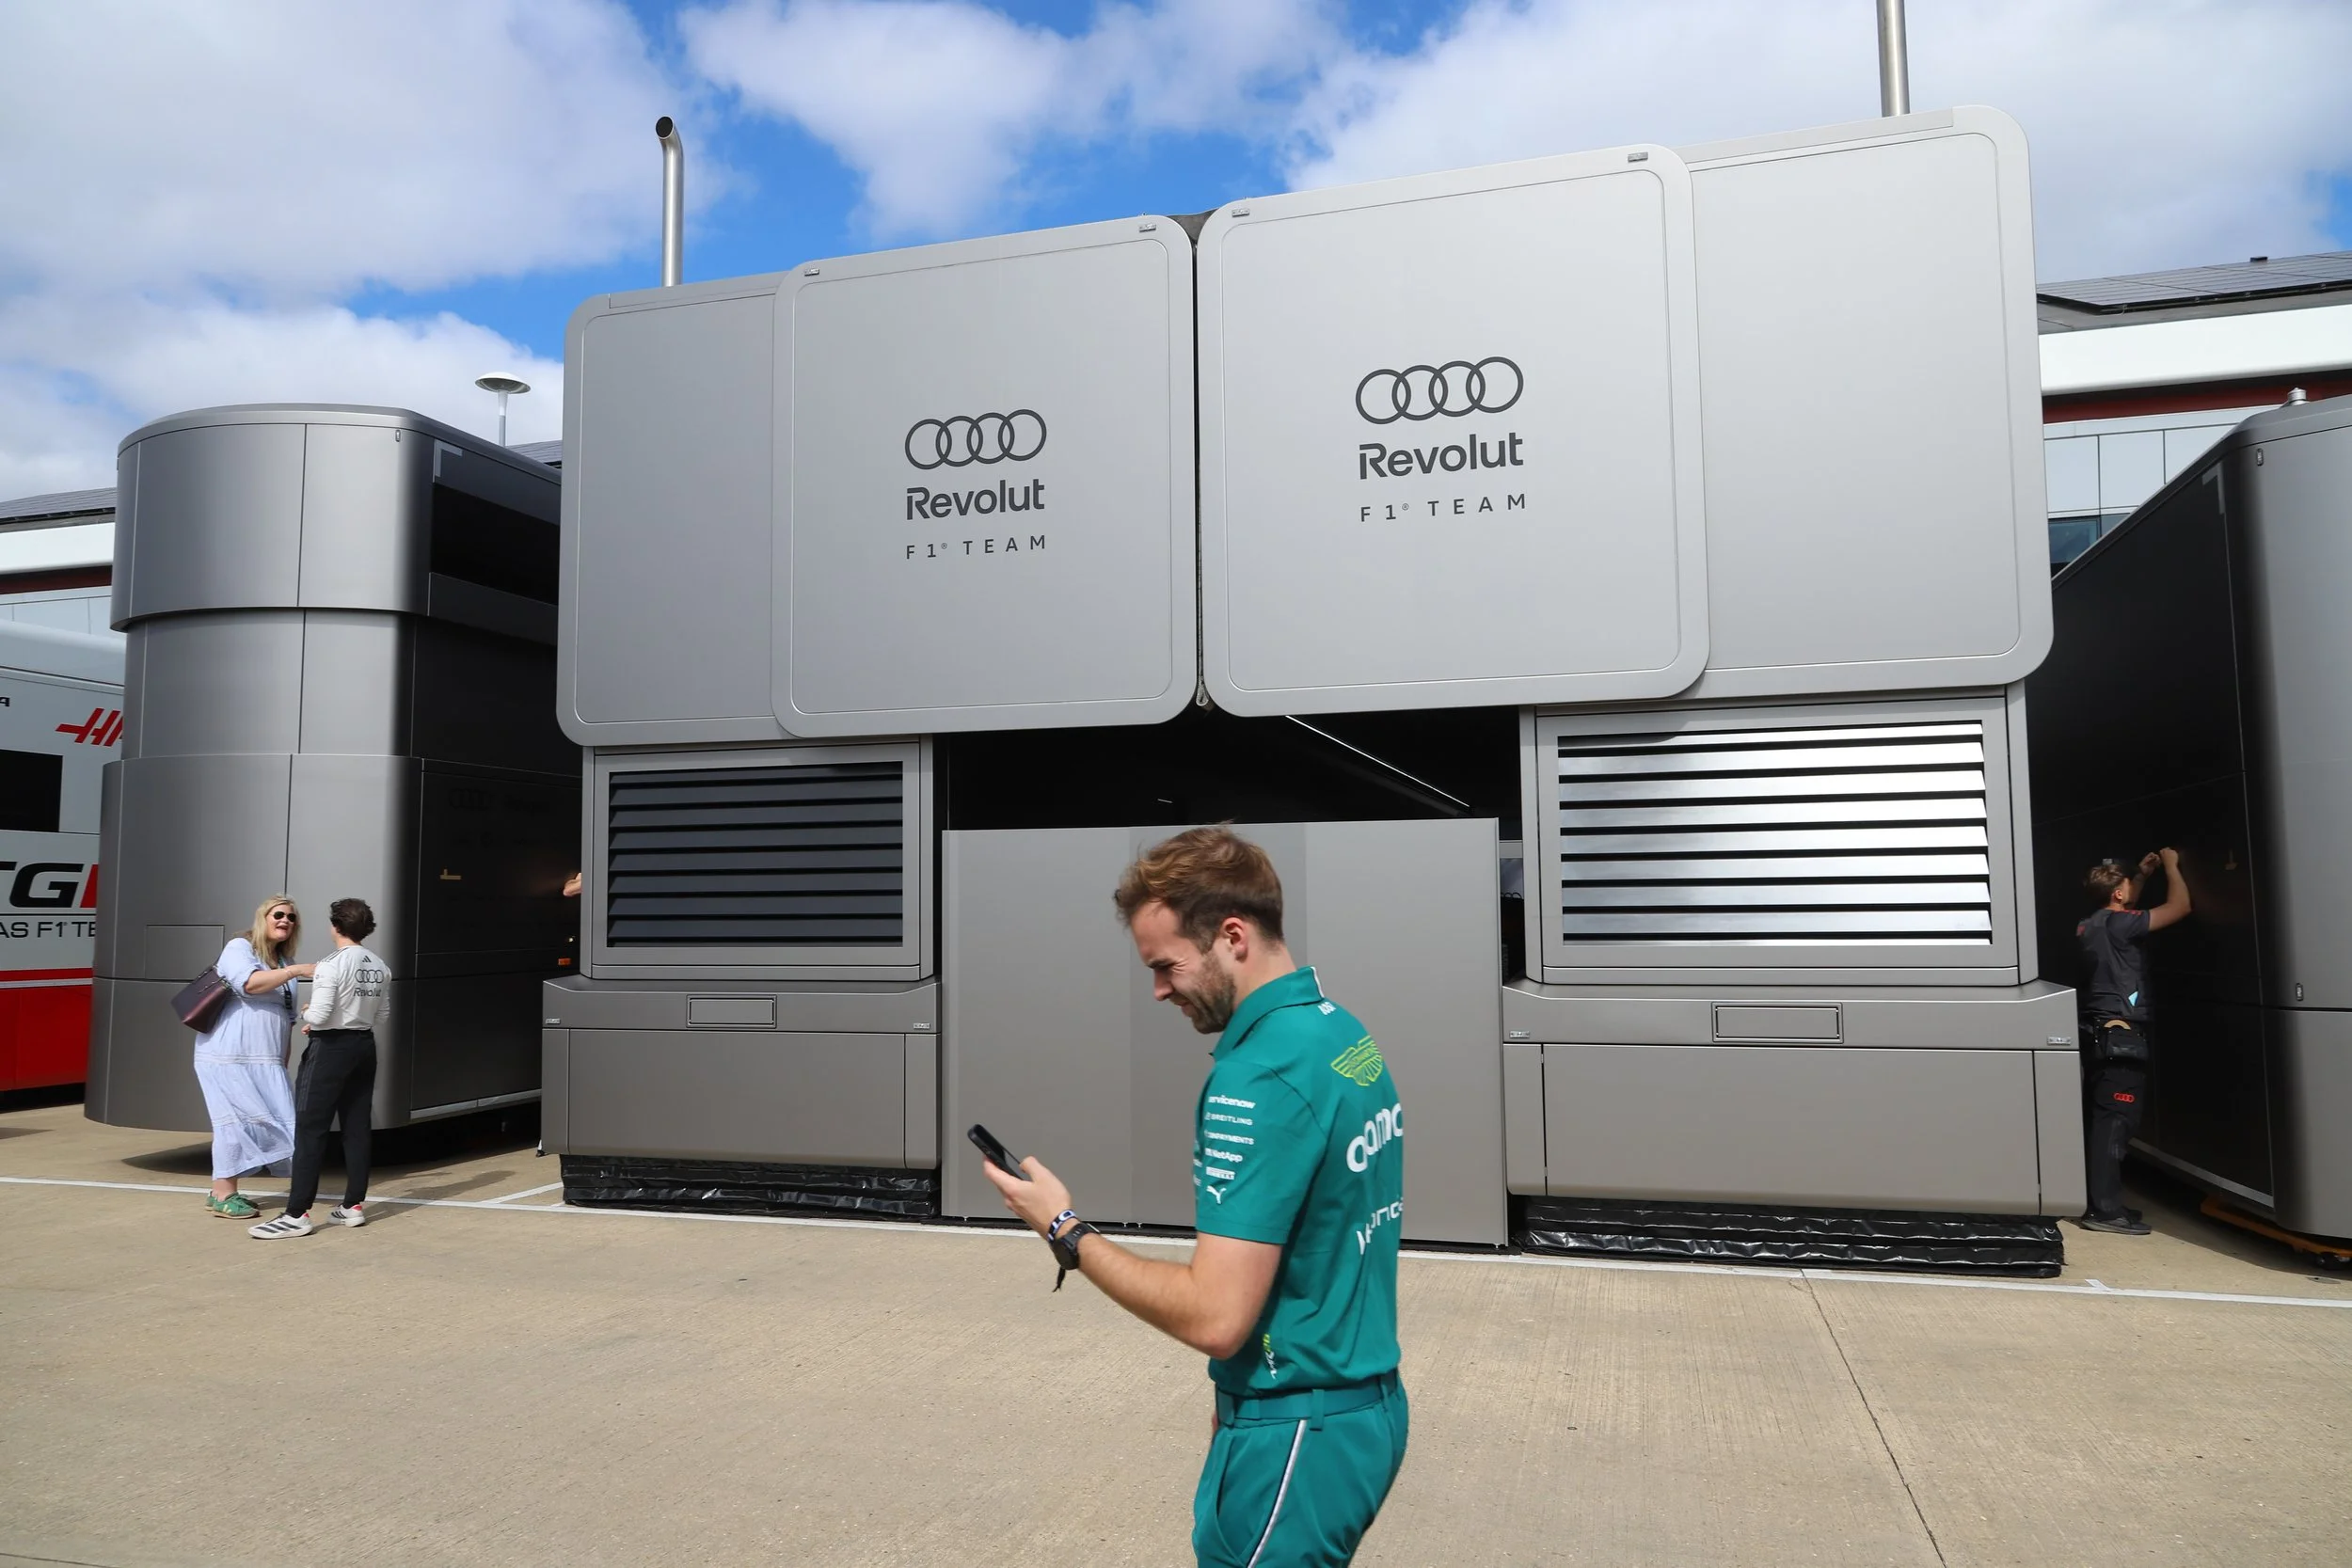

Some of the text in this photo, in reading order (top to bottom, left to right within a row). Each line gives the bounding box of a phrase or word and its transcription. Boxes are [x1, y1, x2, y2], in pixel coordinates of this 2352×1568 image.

[1359, 432, 1524, 480] Revolut
[906, 478, 1045, 520] Revolut
[1427, 493, 1526, 516] TEAM
[962, 534, 1045, 555] TEAM
